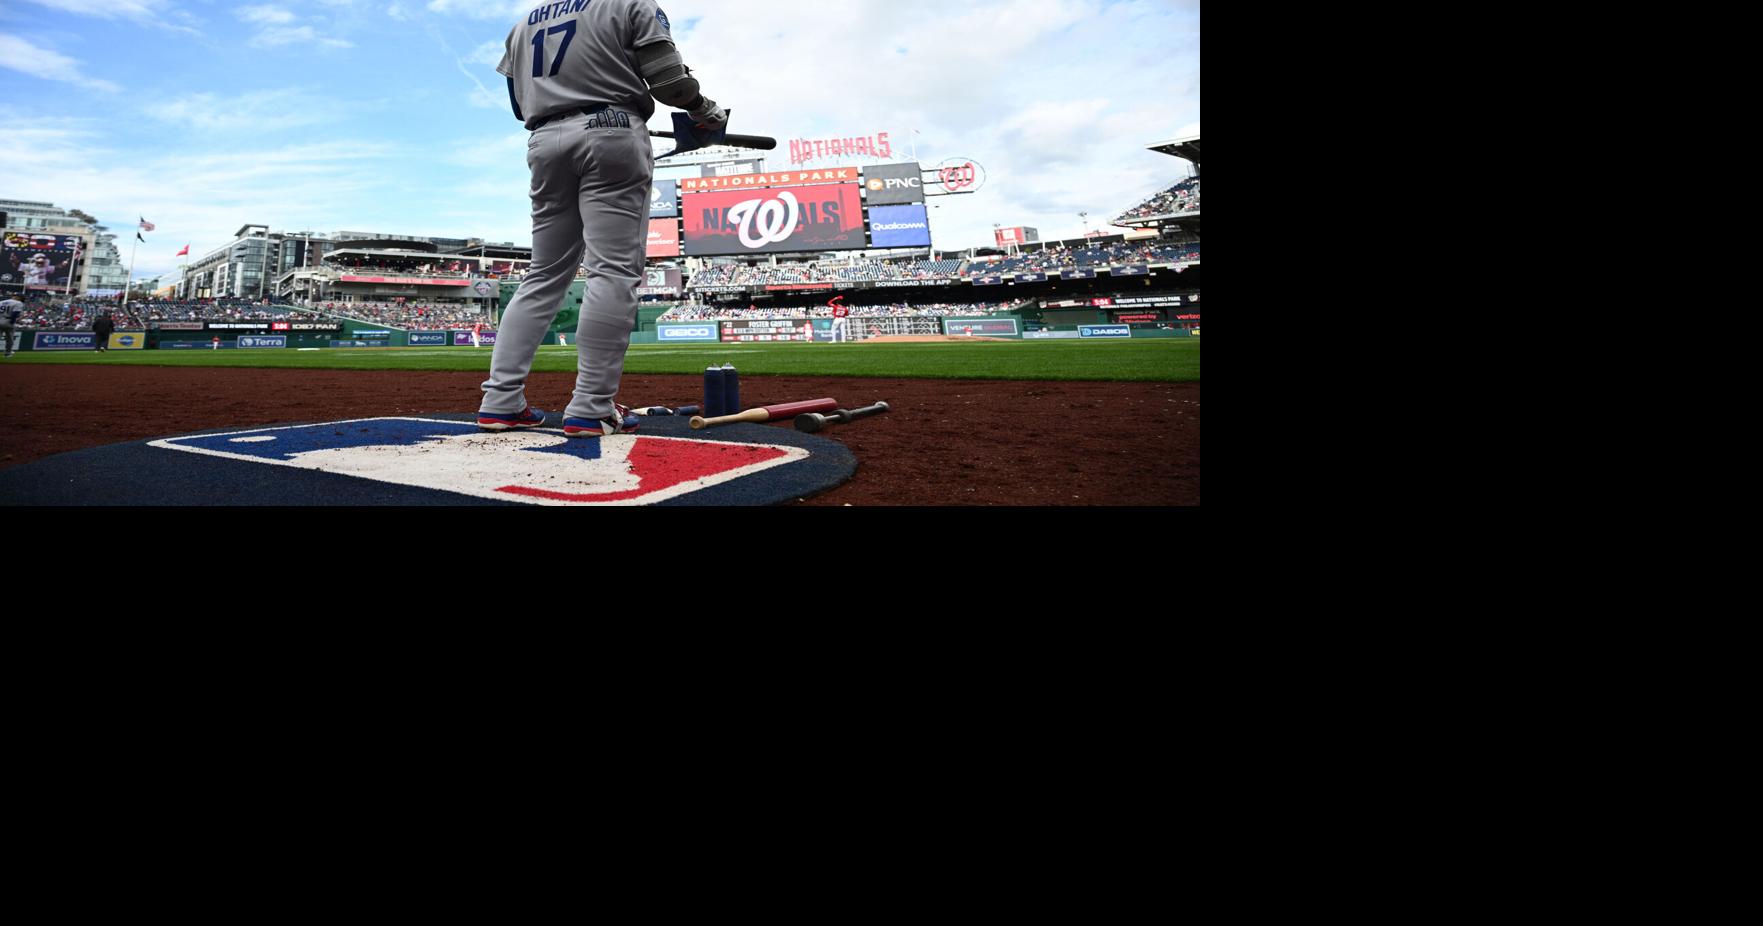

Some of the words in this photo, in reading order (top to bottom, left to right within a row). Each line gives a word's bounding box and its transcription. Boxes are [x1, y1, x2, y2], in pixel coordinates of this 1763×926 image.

[531, 19, 577, 78] 17
[789, 132, 892, 165] NATIONALS
[687, 173, 790, 189] NATIONALS
[799, 169, 848, 181] PARK
[885, 177, 920, 189] PNC
[872, 221, 926, 232] Qualcomm
[875, 280, 919, 288] DOWNLOAD
[921, 279, 935, 287] THE
[636, 286, 678, 295] BETMGM
[663, 327, 709, 337] GEICO
[57, 335, 92, 344] Inova
[254, 338, 282, 346] Terra
